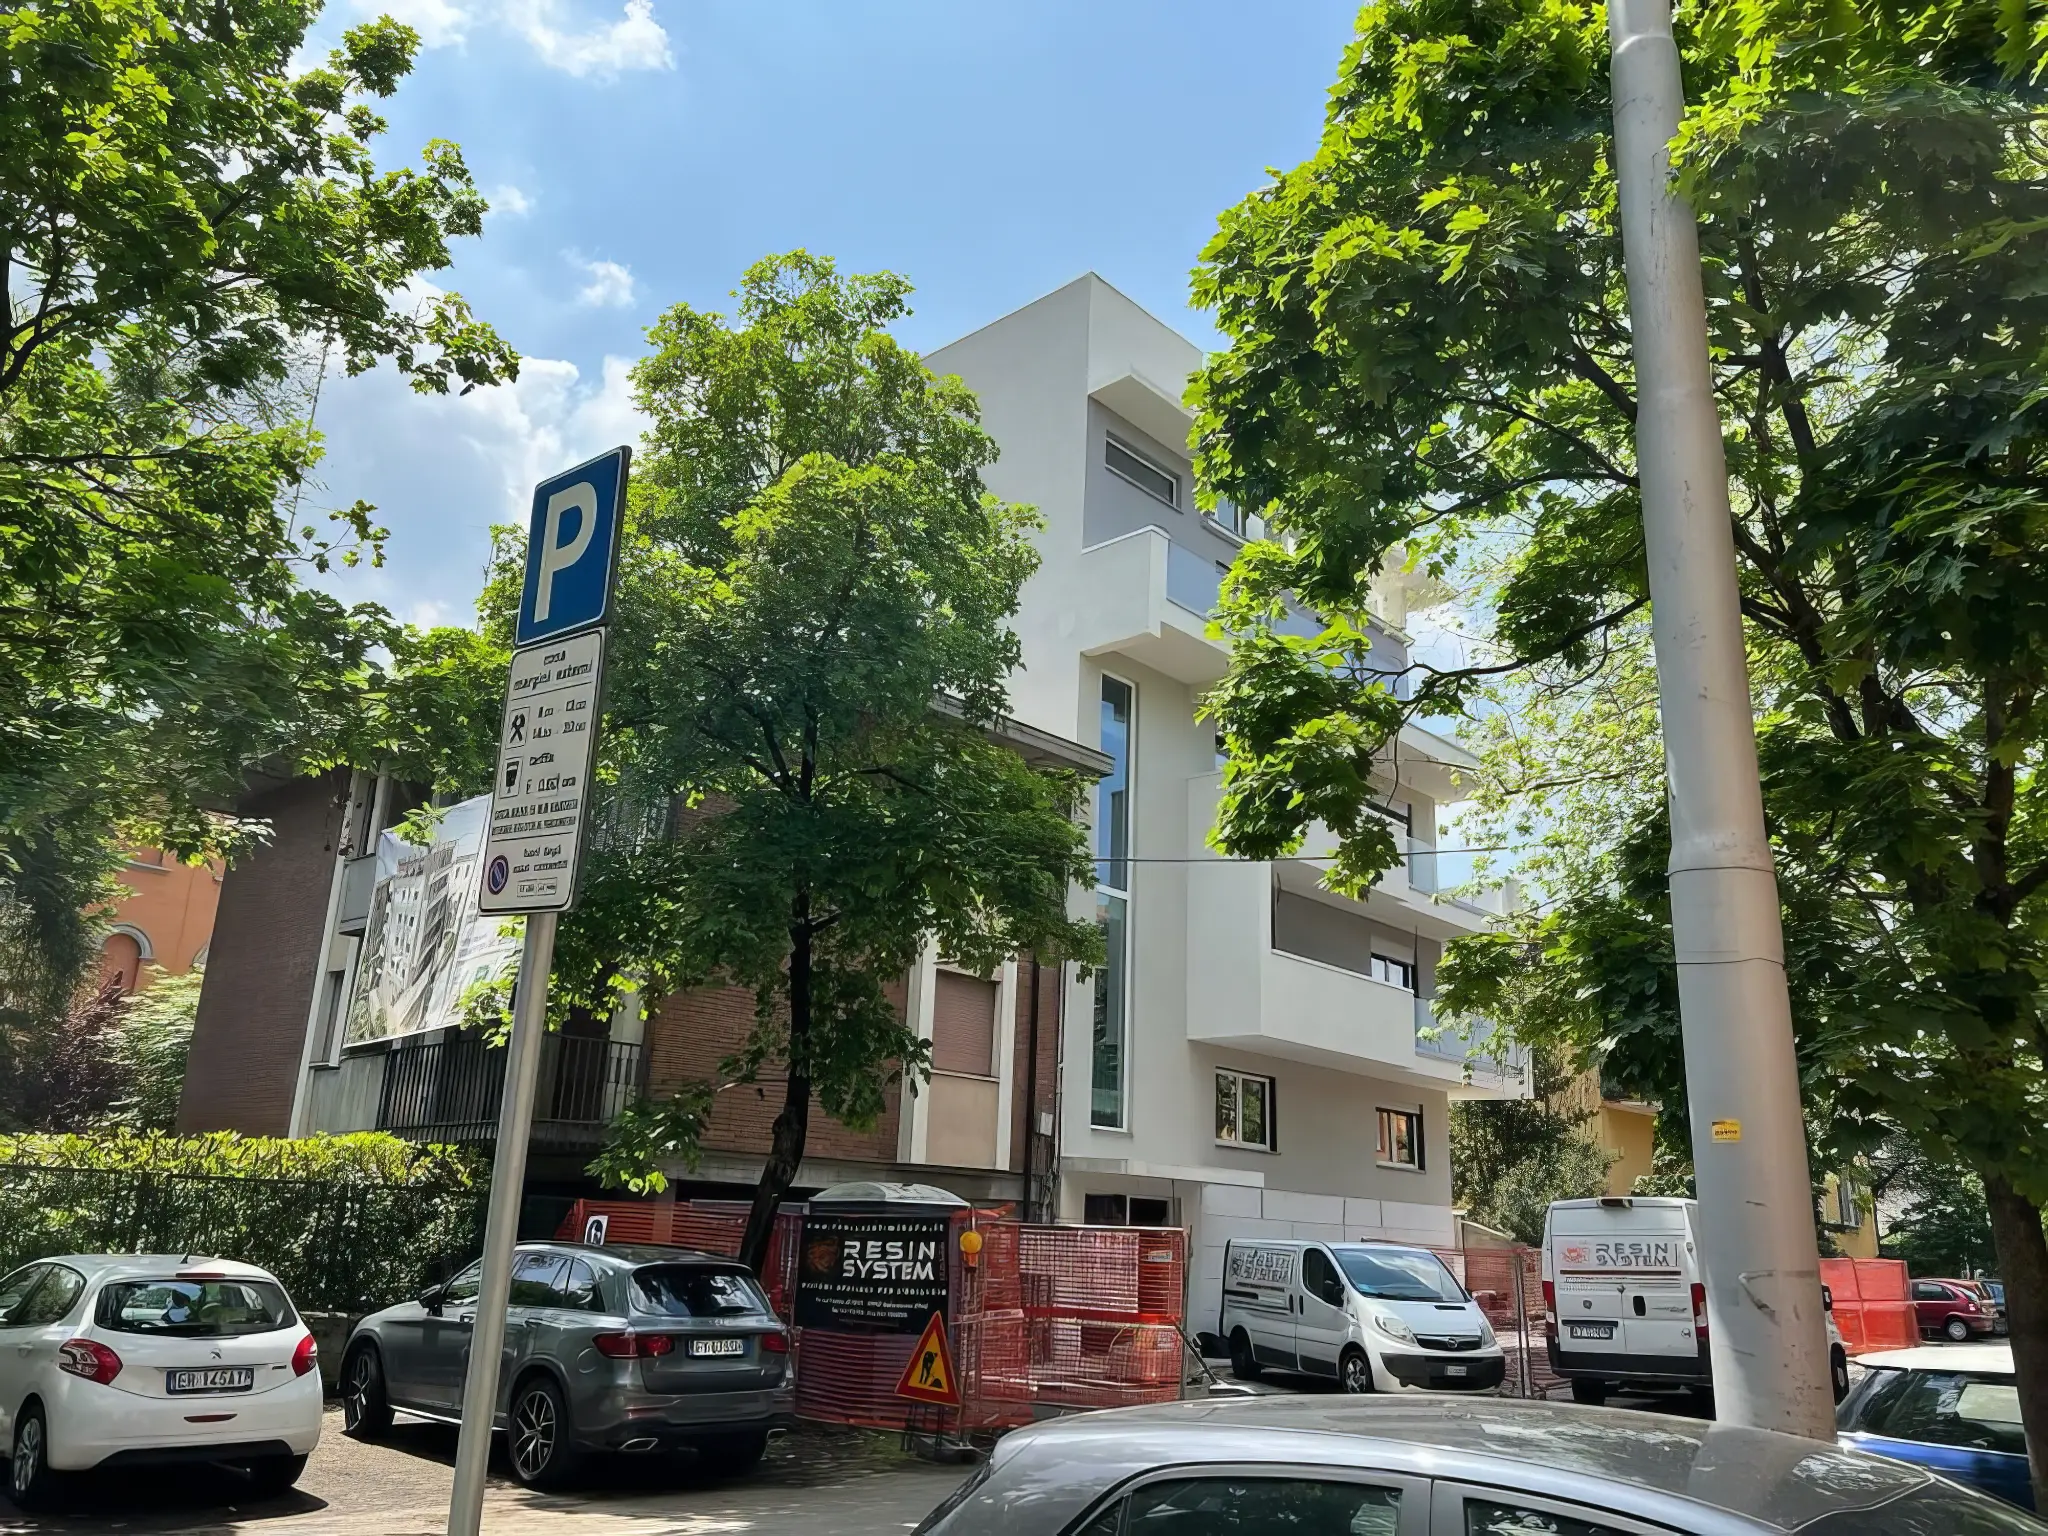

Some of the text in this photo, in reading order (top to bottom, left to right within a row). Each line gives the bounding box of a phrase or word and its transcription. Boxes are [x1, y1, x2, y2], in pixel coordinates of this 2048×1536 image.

[534, 481, 597, 623] P
[843, 1240, 936, 1261] RESIN
[1595, 1242, 1669, 1255] RESIN
[842, 1259, 935, 1281] SYSTEM
